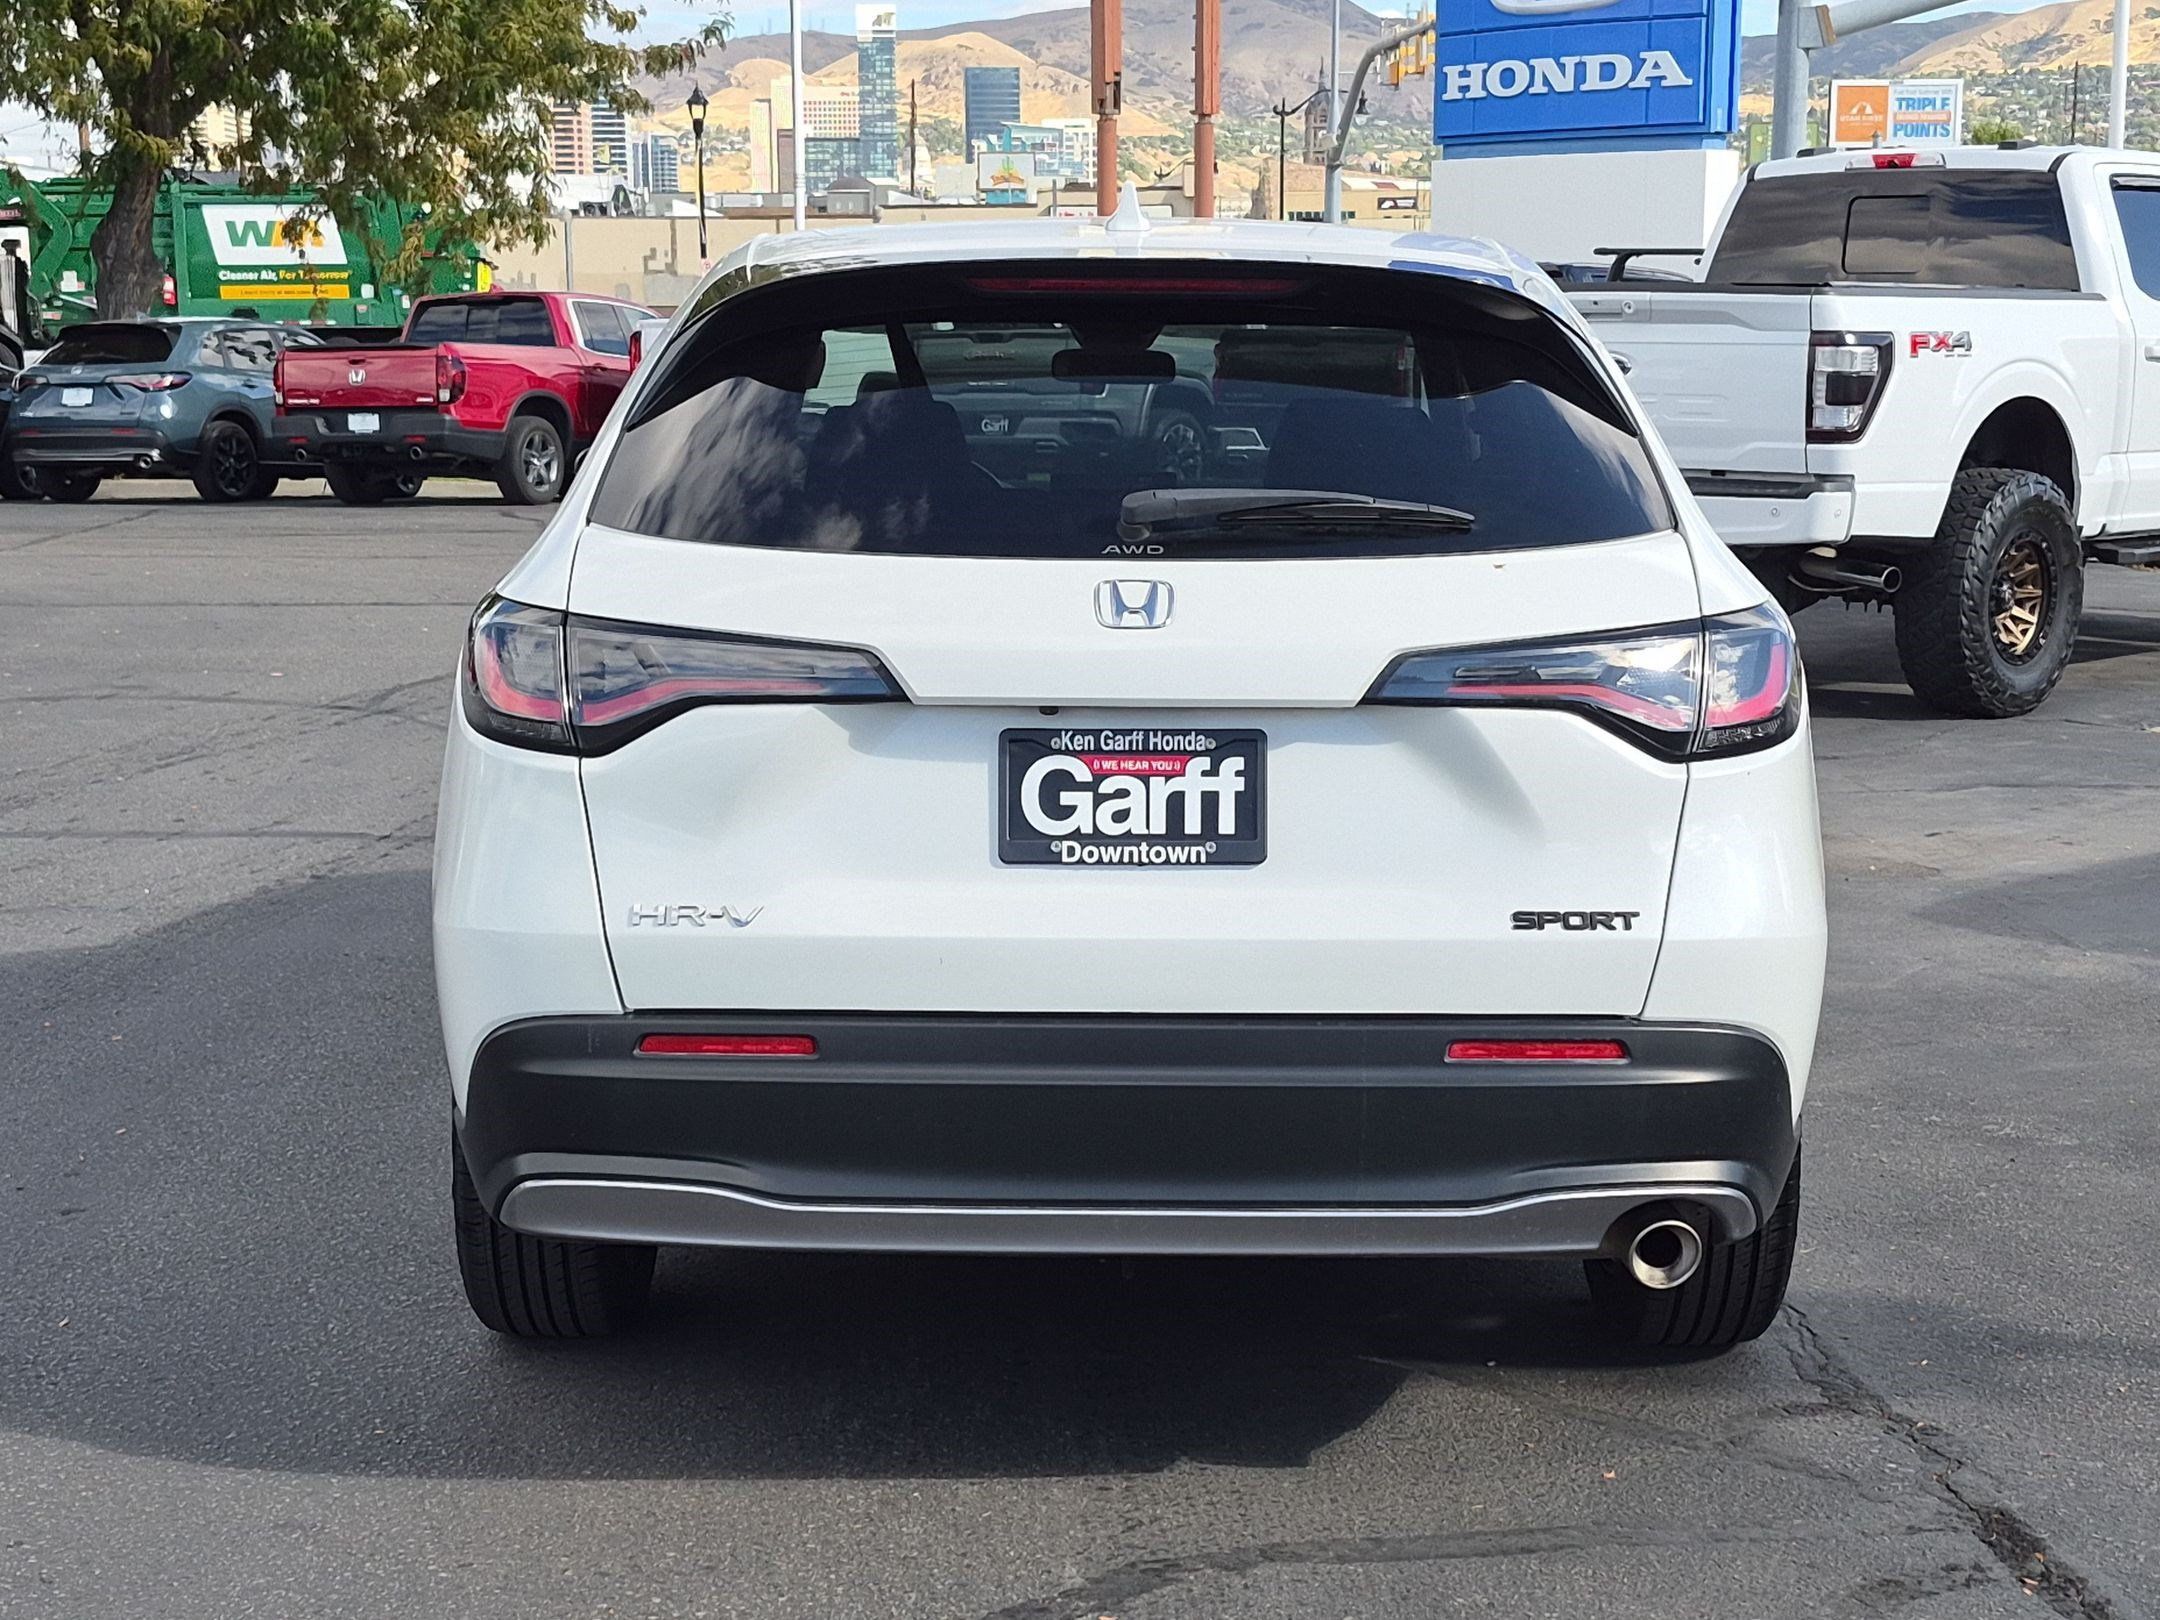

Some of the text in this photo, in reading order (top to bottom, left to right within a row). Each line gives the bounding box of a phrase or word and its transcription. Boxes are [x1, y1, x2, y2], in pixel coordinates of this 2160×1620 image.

[1442, 50, 1693, 100] HONDA
[1895, 97, 1951, 110] TRIPLE
[1893, 123, 1951, 138] POINTS
[218, 270, 259, 281] Cleaner
[279, 270, 296, 280] For
[1909, 331, 1972, 358] FX4
[1101, 545, 1164, 554] AWD
[1060, 730, 1206, 751] Ken Garff Honda
[1101, 760, 1173, 771] WE HEAR YOU
[1020, 754, 1245, 836] Garff
[1061, 840, 1207, 864] Downtown
[630, 904, 764, 928] HR-V
[1511, 911, 1640, 931] SPORT
